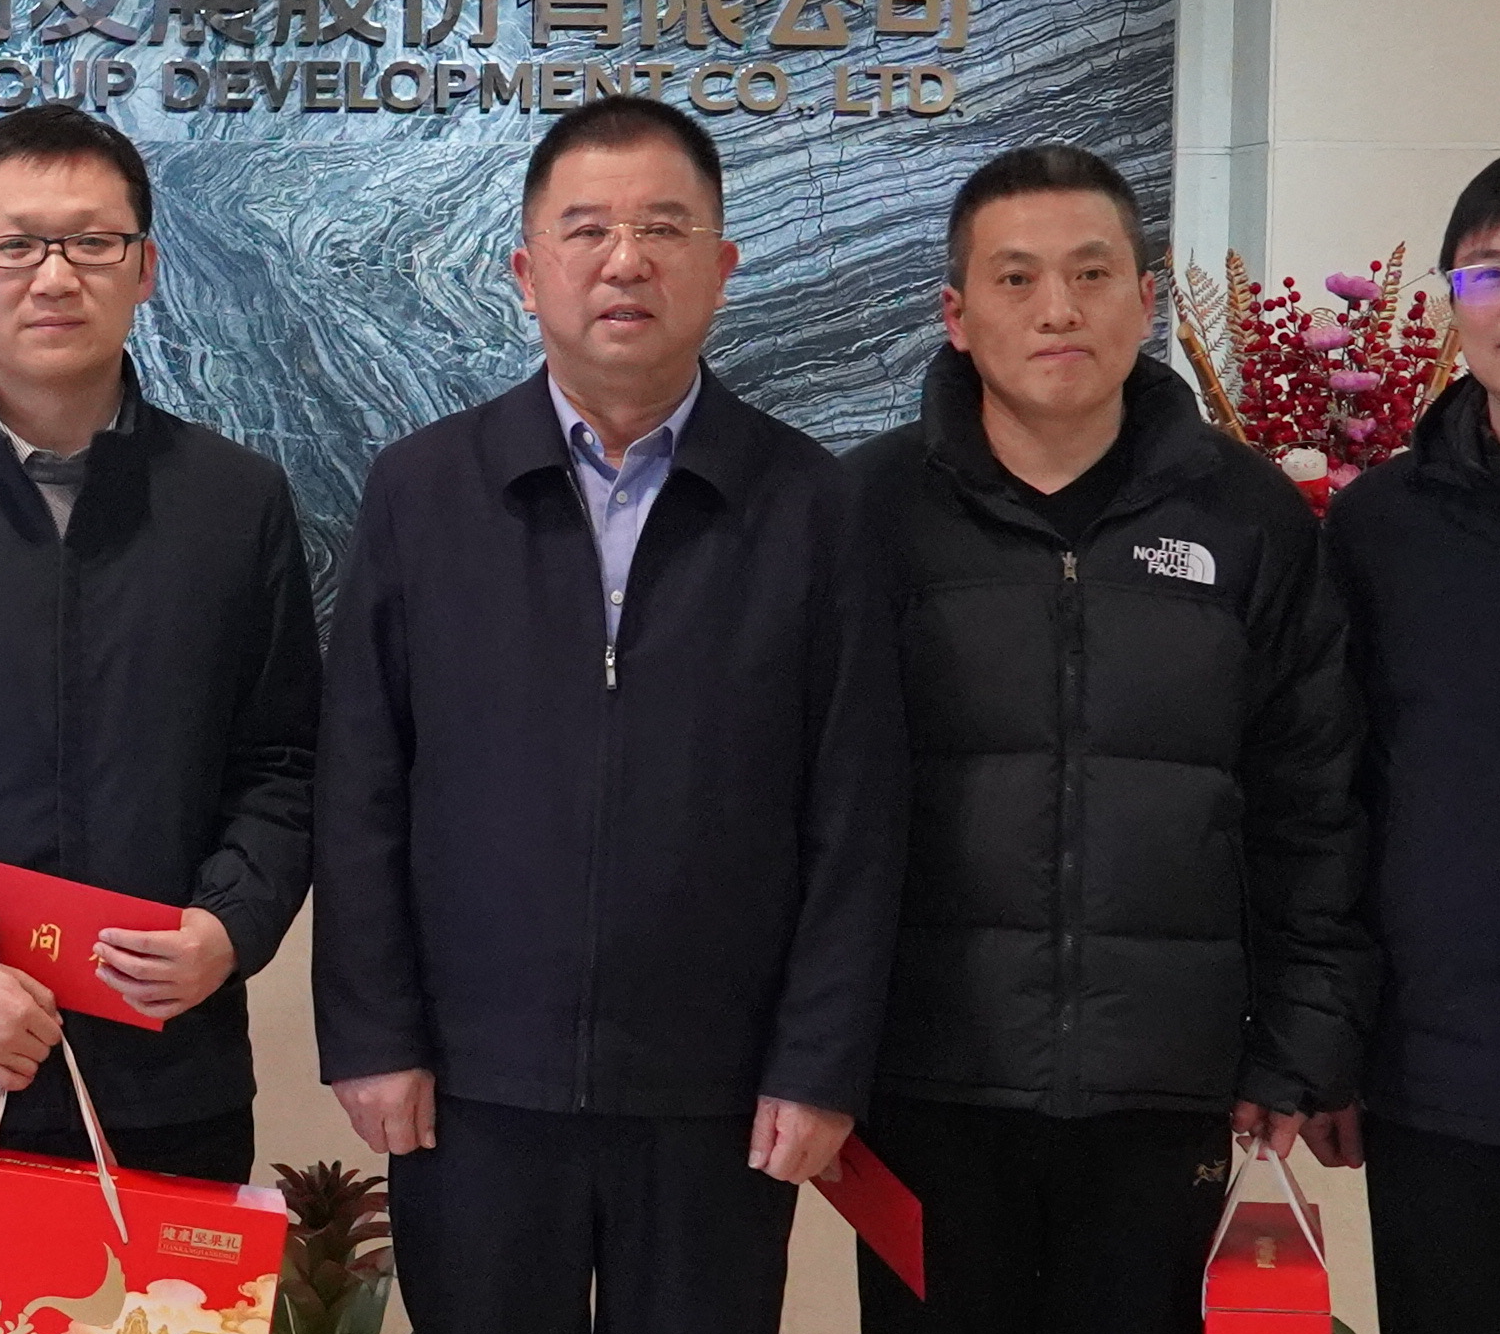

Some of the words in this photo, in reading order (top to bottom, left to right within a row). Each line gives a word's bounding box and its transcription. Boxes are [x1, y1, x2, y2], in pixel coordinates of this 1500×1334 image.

[160, 58, 675, 115] DEVELOPMENT
[1158, 536, 1190, 554] THE
[1132, 545, 1189, 567] NORTH
[1147, 561, 1189, 579] FACE
